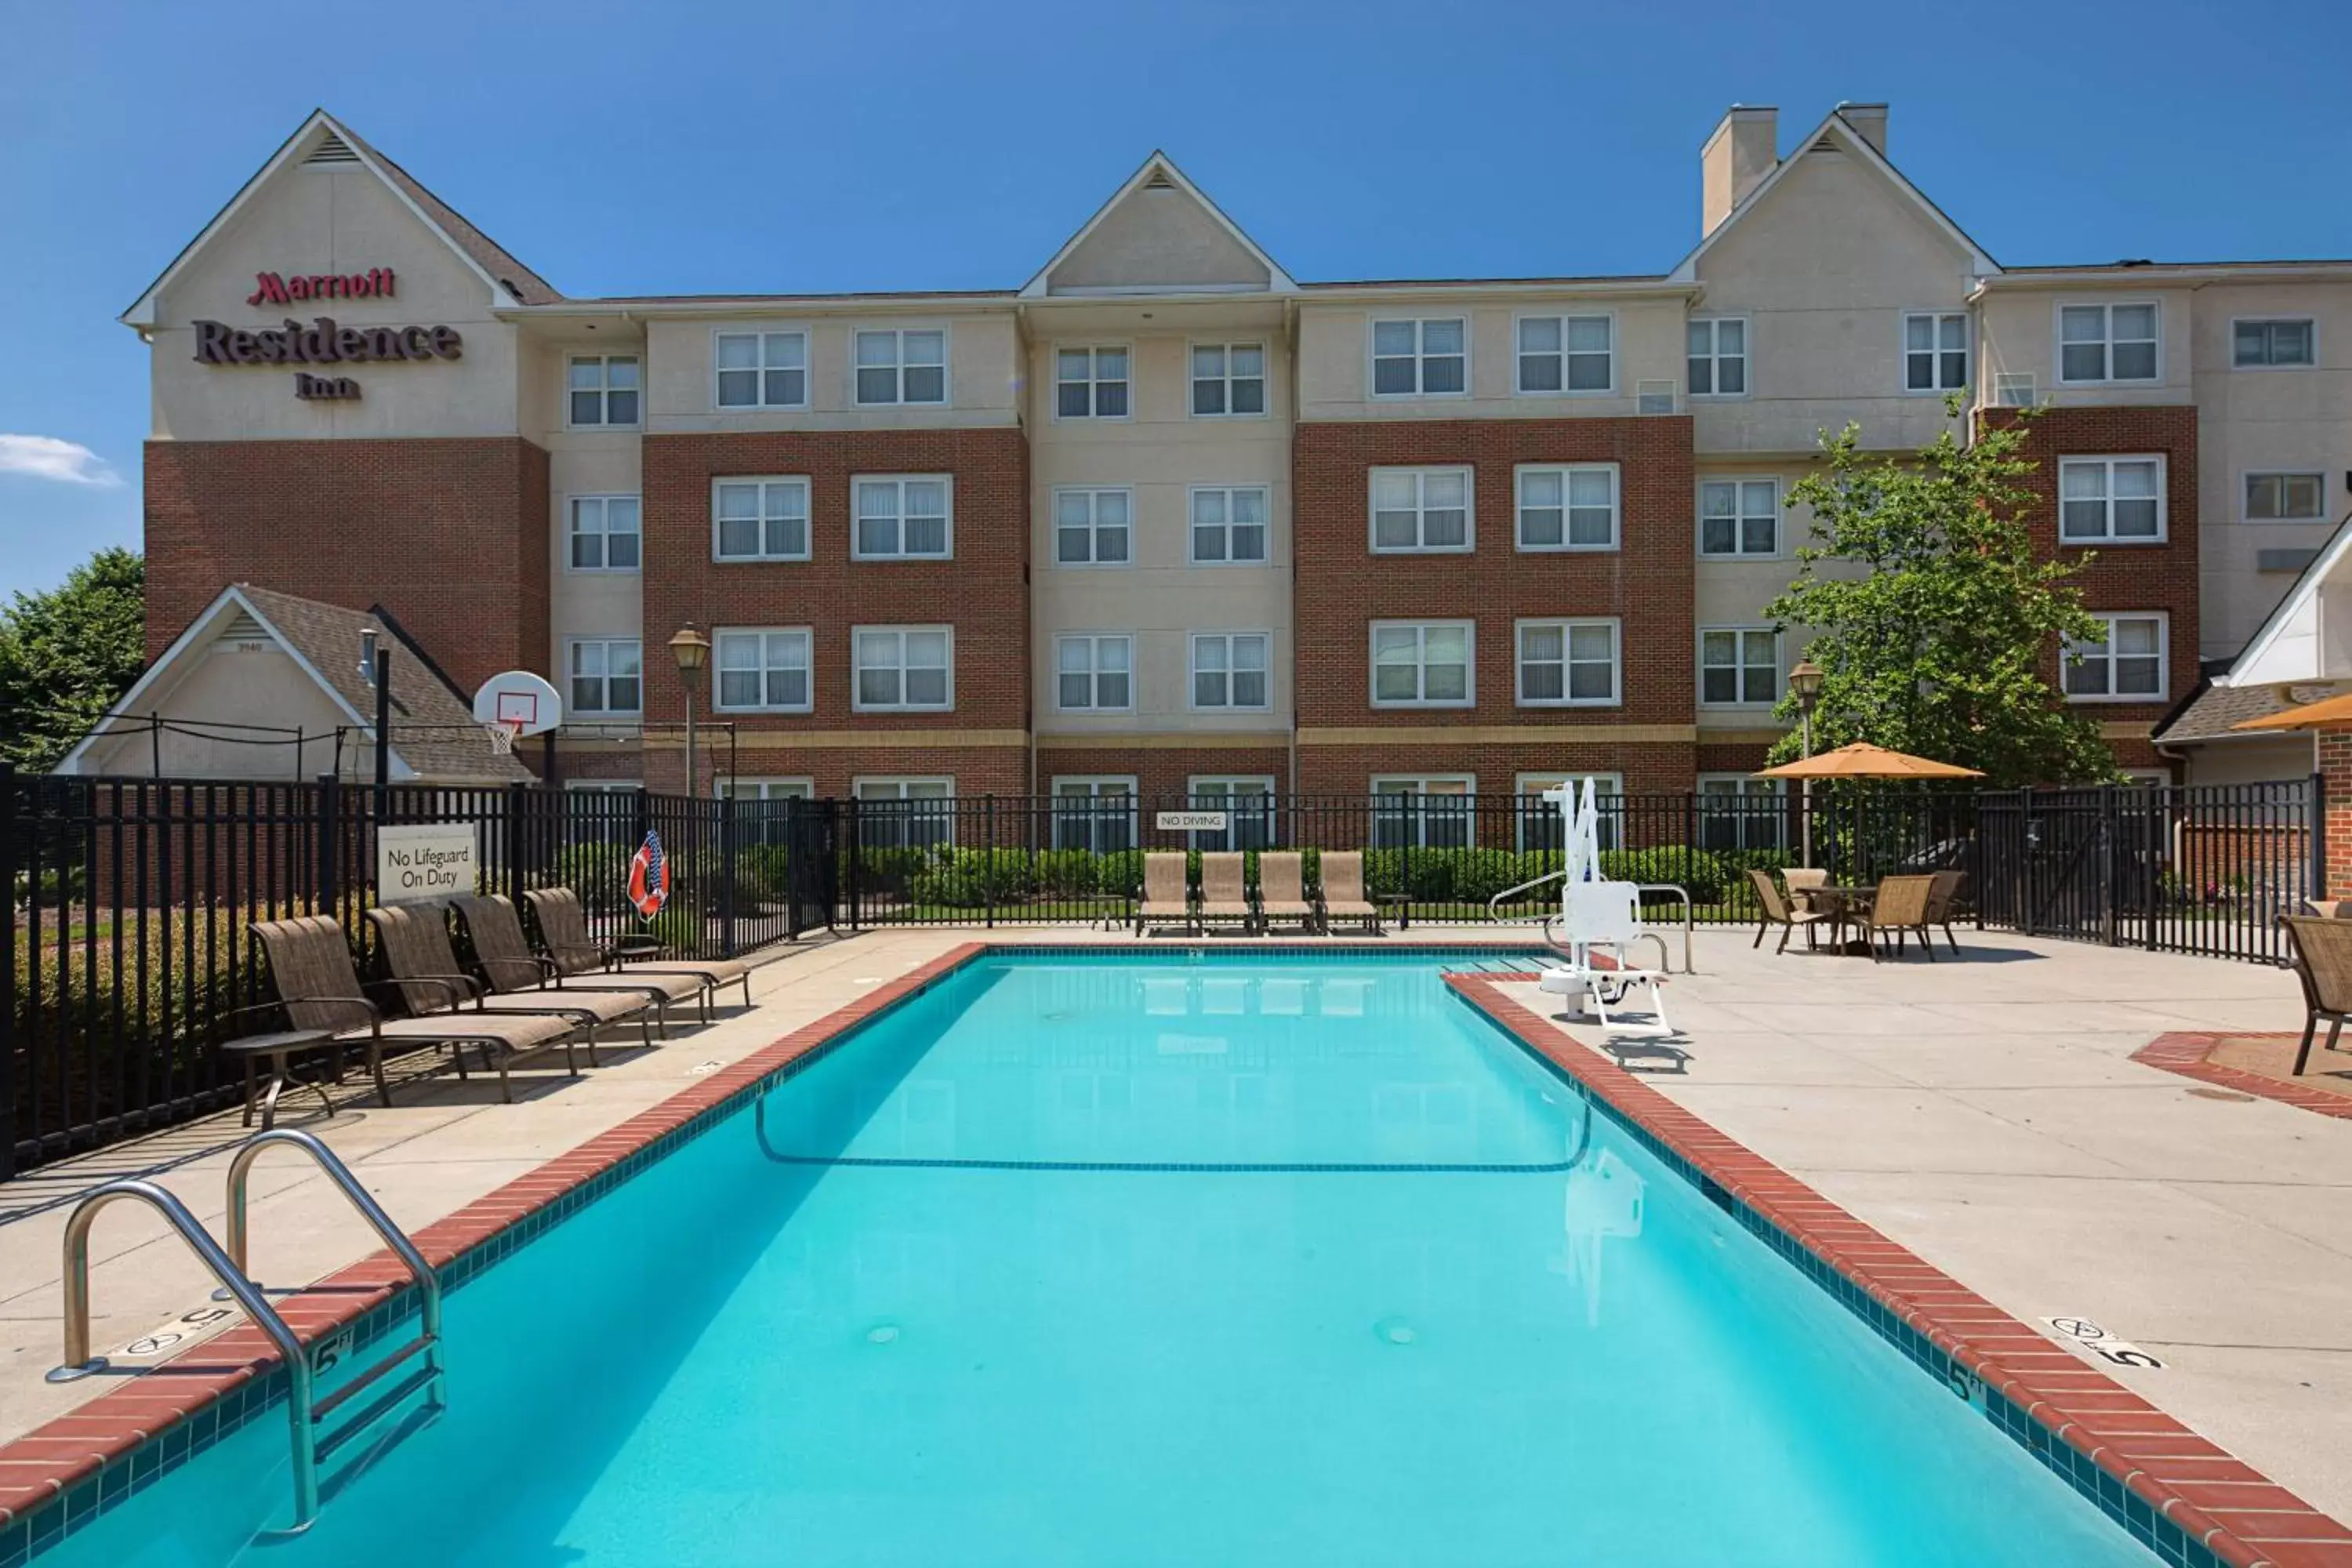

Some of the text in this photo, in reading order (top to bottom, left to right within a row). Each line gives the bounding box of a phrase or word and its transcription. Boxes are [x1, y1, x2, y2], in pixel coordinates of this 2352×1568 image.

[246, 267, 394, 306] Marriott
[192, 317, 463, 363] Residence
[293, 372, 362, 400] Inn
[1161, 816, 1221, 826] NO DIVING
[388, 846, 468, 869] No Lifeguard
[401, 869, 457, 887] On Duty
